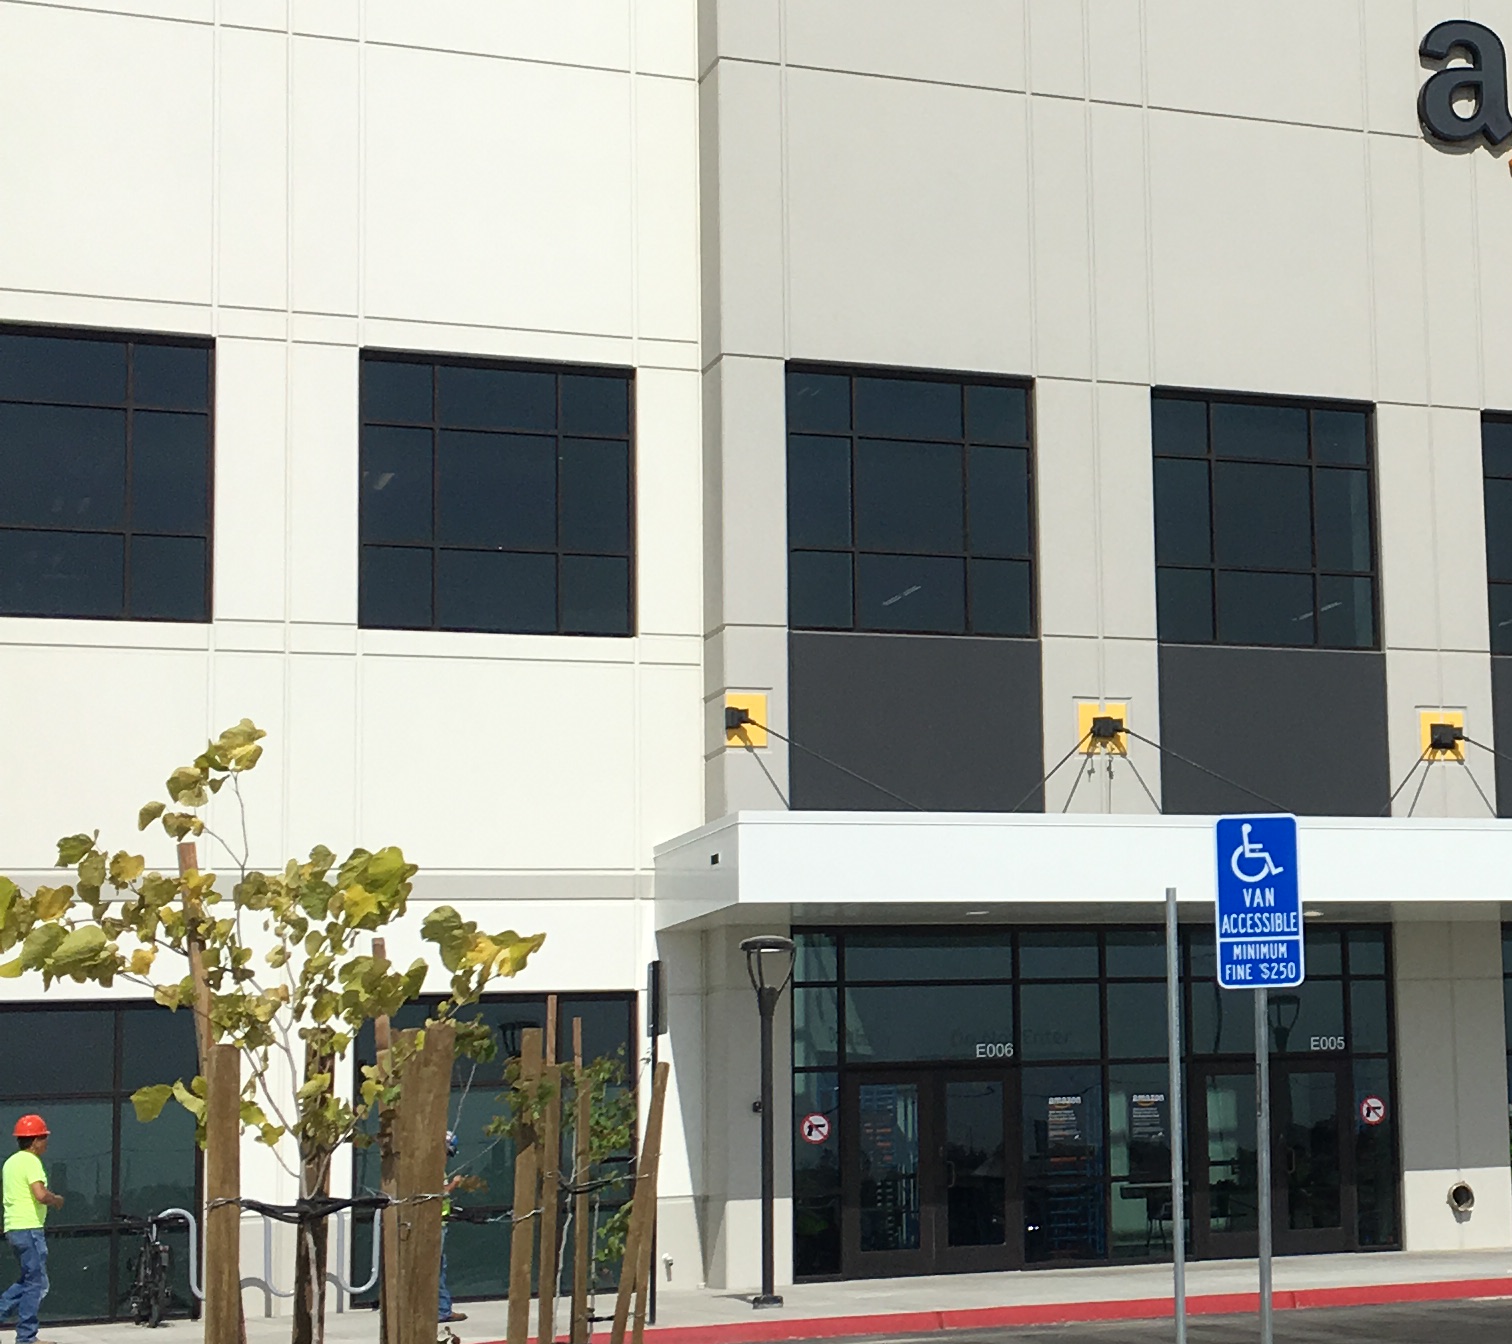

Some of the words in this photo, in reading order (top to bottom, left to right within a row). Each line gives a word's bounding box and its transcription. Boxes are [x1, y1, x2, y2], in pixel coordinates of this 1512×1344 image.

[1243, 887, 1275, 908] VAN
[1221, 912, 1298, 934] ACCESSIBLE
[1233, 943, 1288, 961] MINIMUM
[1225, 964, 1253, 981] FINE
[1258, 962, 1296, 980] $250
[975, 1042, 1014, 1059] E006
[1310, 1036, 1346, 1051] E005
